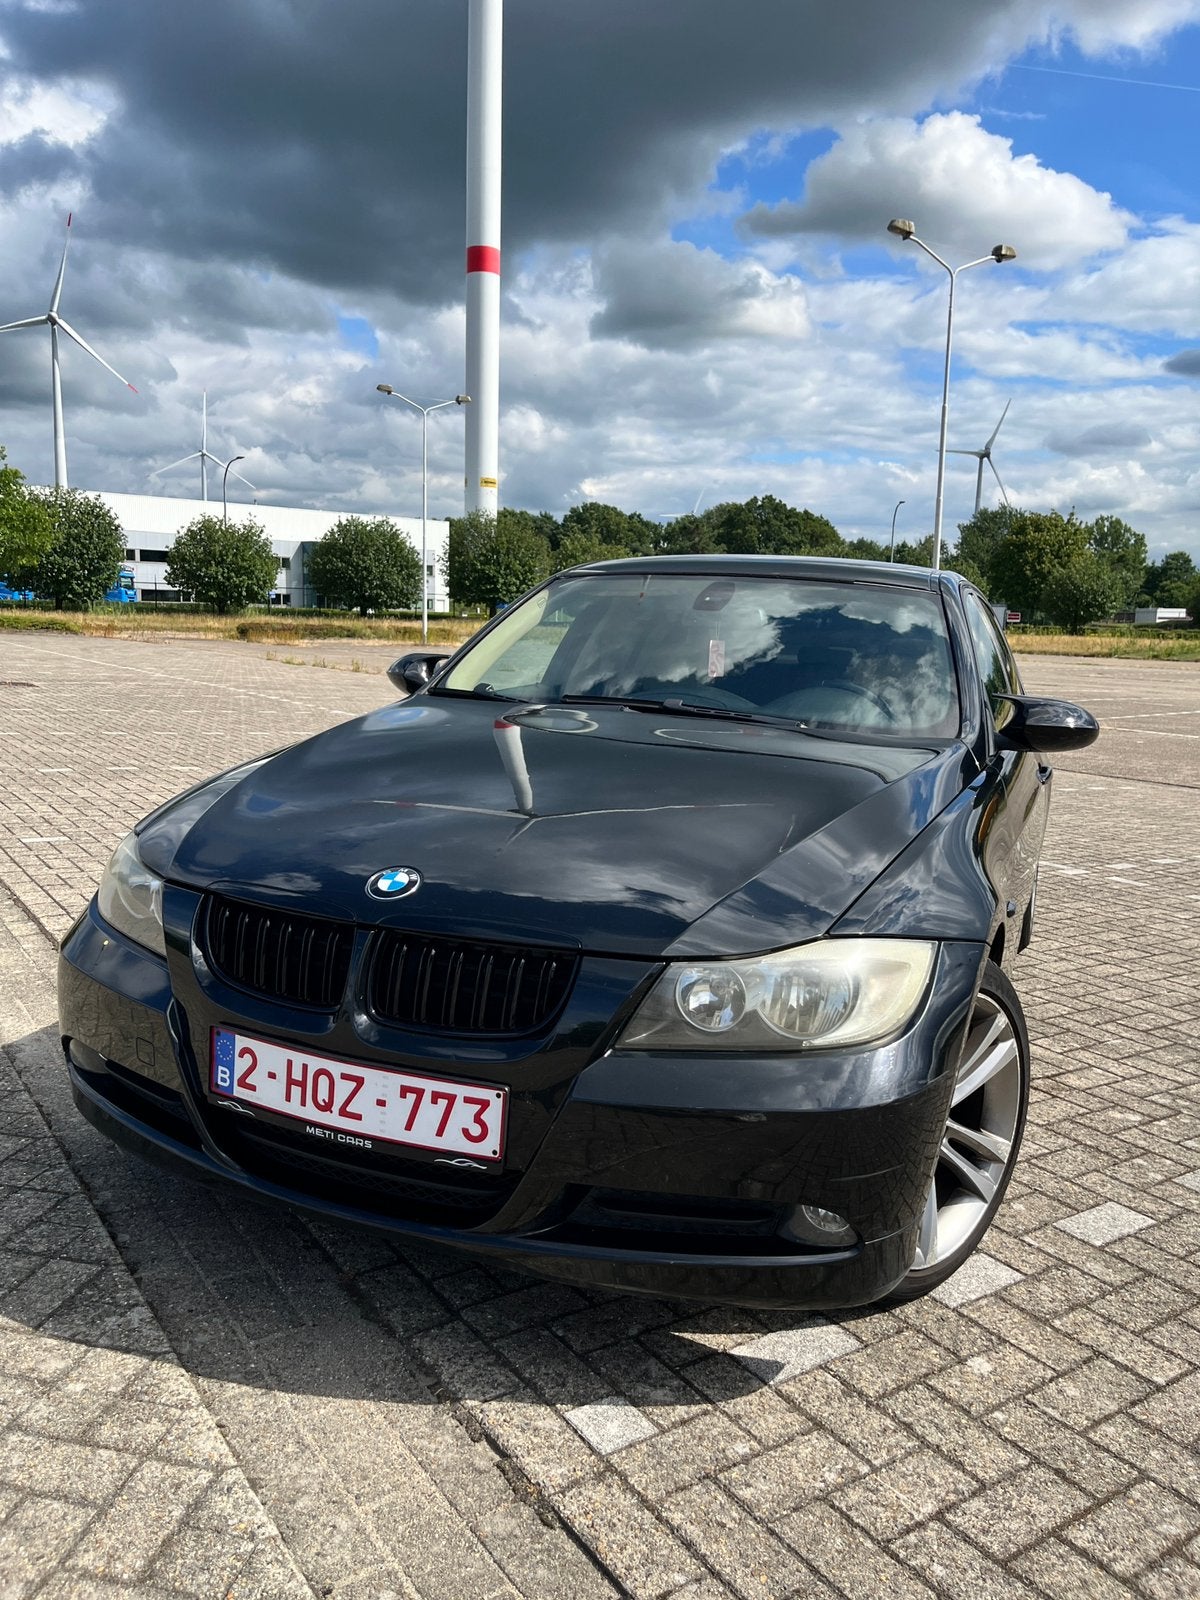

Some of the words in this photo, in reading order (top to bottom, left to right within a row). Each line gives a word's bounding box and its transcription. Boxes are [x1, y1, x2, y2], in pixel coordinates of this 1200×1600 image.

[217, 1065, 230, 1087] B
[237, 1046, 491, 1143] 2-HQZ-773
[306, 1125, 334, 1140] METI
[337, 1134, 372, 1149] CARS
